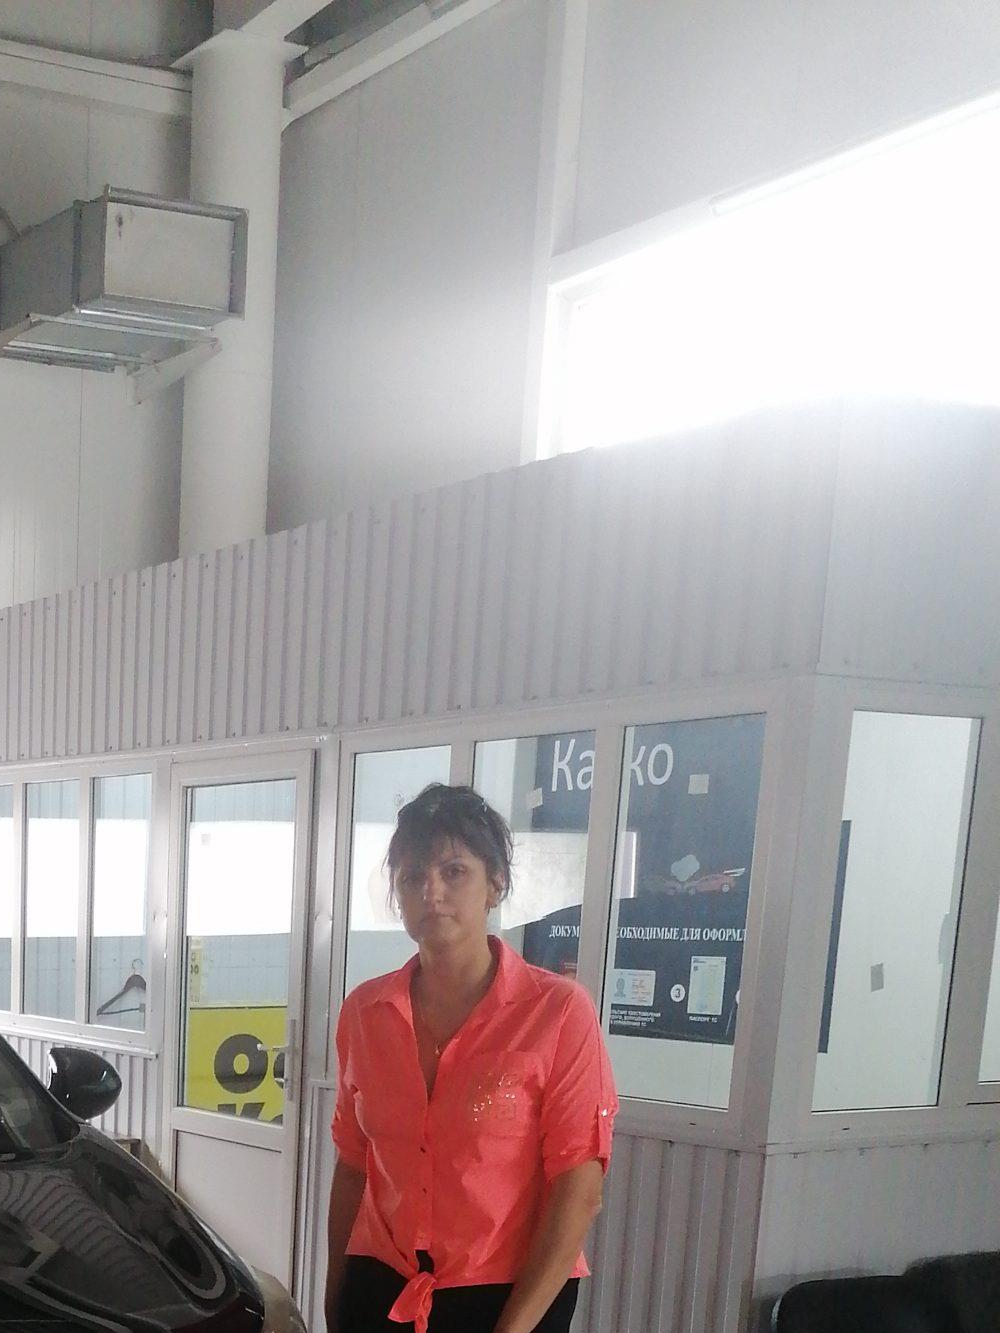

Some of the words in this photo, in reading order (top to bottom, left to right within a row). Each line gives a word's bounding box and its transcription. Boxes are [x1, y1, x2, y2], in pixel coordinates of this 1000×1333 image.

[552, 739, 674, 792] Како
[549, 925, 580, 938] ДОКУМ
[680, 927, 701, 942] ДЛЯ
